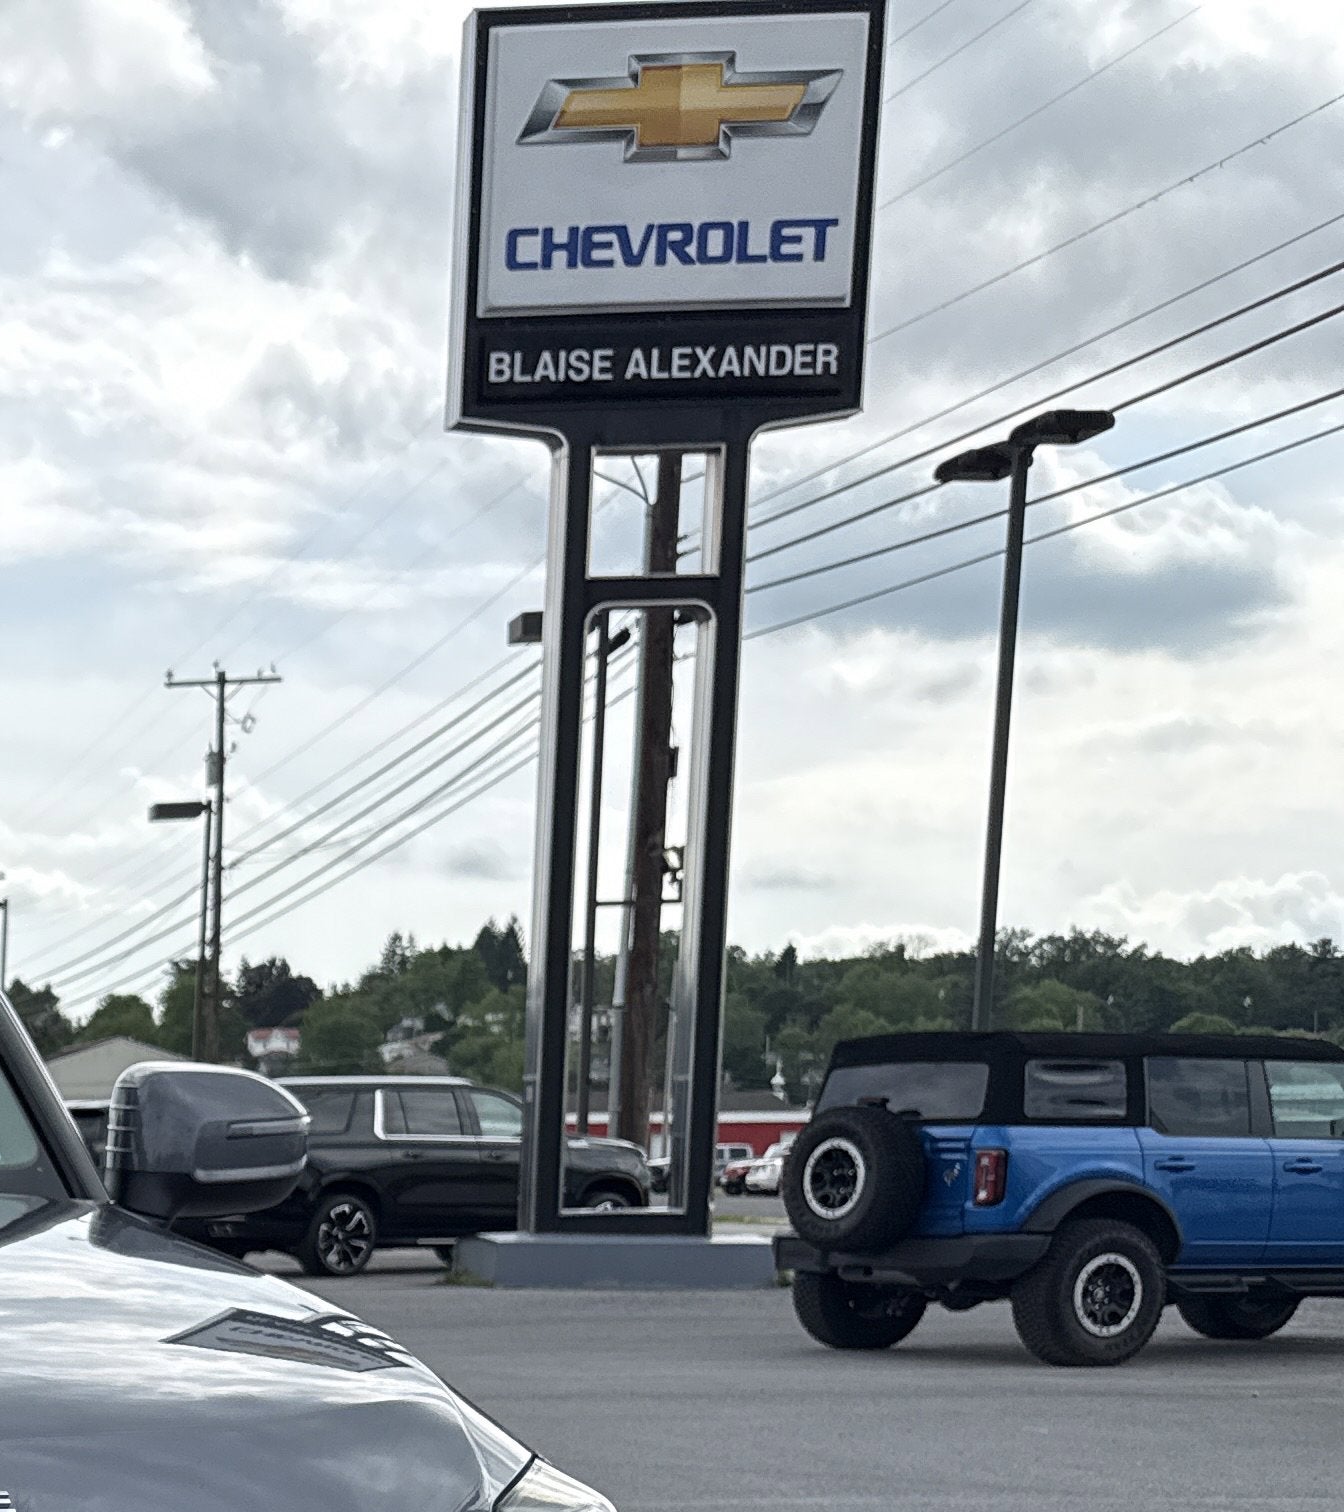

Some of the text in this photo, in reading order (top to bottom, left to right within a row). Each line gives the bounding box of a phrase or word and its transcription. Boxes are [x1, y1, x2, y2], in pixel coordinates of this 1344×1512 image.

[505, 218, 839, 271] CHEVROLET
[488, 342, 838, 383] BLAISE ALEXANDER
